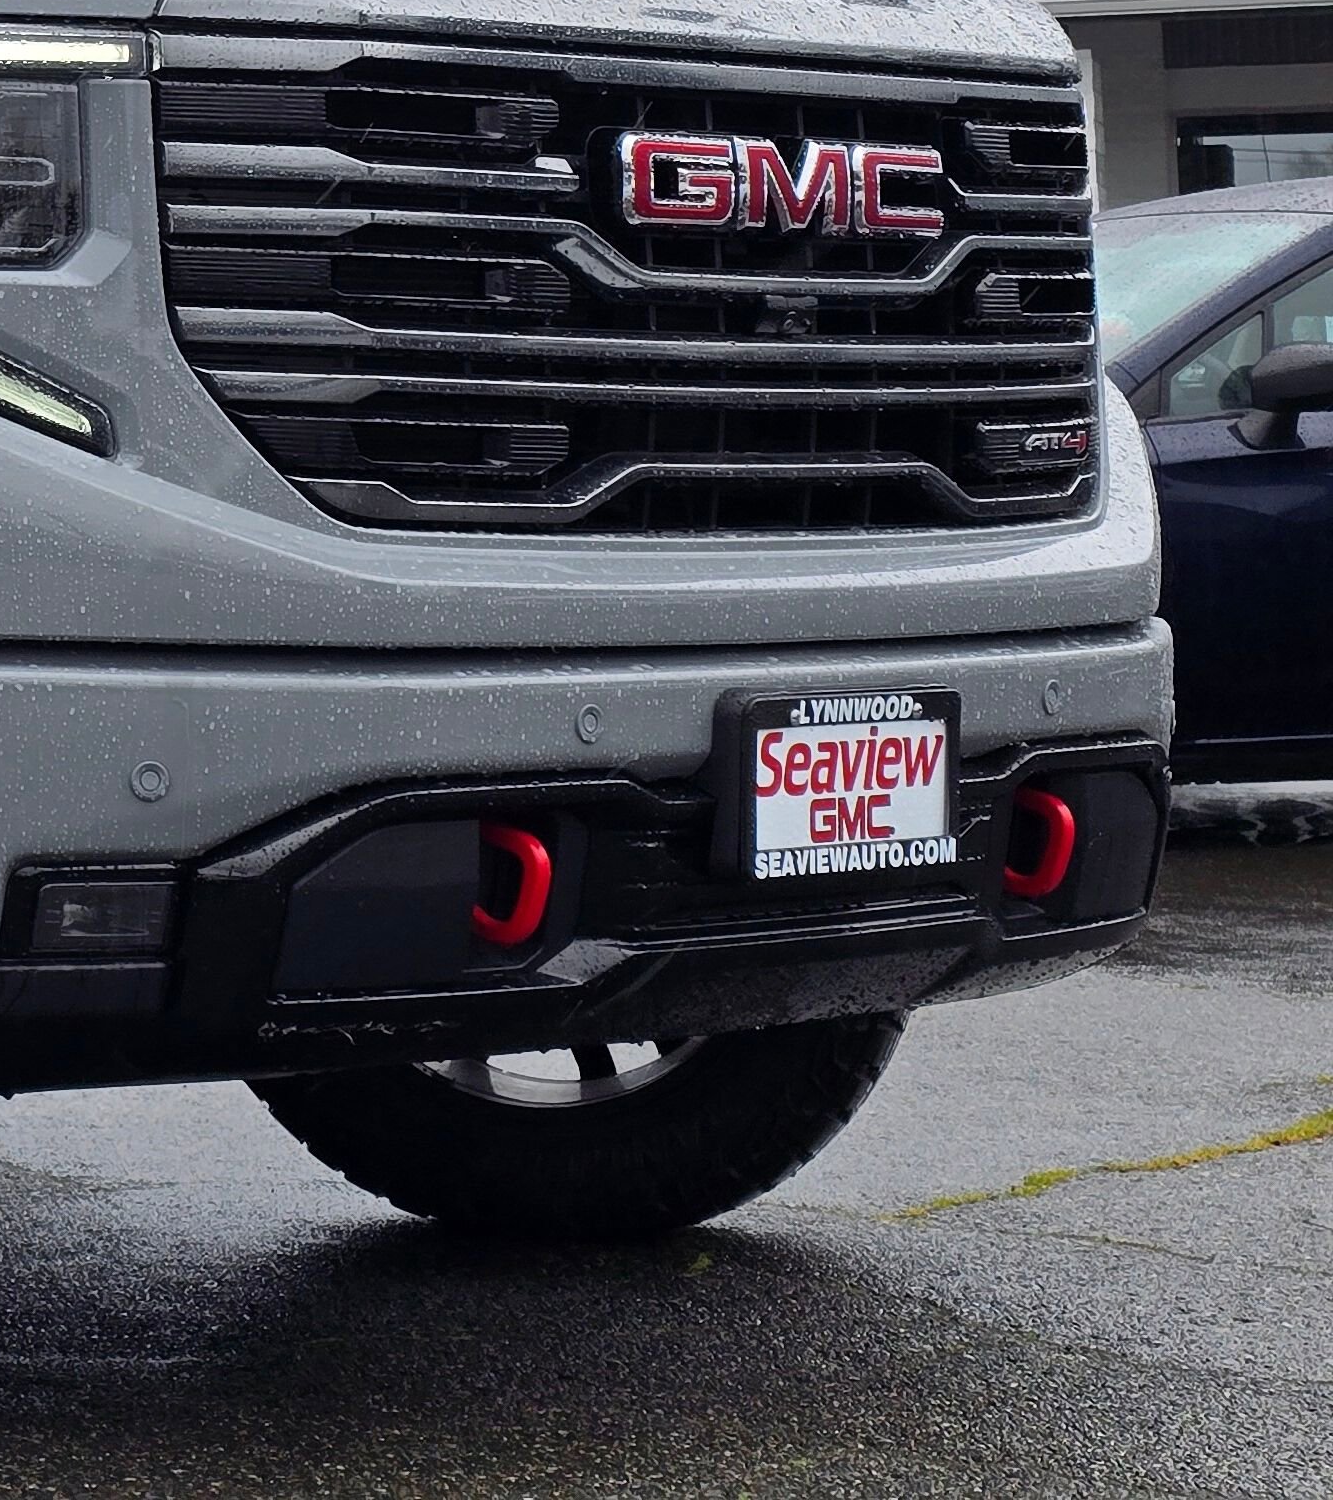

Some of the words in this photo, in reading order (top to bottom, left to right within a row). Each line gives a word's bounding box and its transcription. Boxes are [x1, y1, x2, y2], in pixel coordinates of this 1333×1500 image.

[620, 130, 945, 239] GMC
[798, 694, 915, 726] LYNNWOOD
[755, 725, 945, 798] Seaview
[808, 793, 896, 844] GMC
[753, 835, 958, 880] SEAVIEWAUTO.COM
